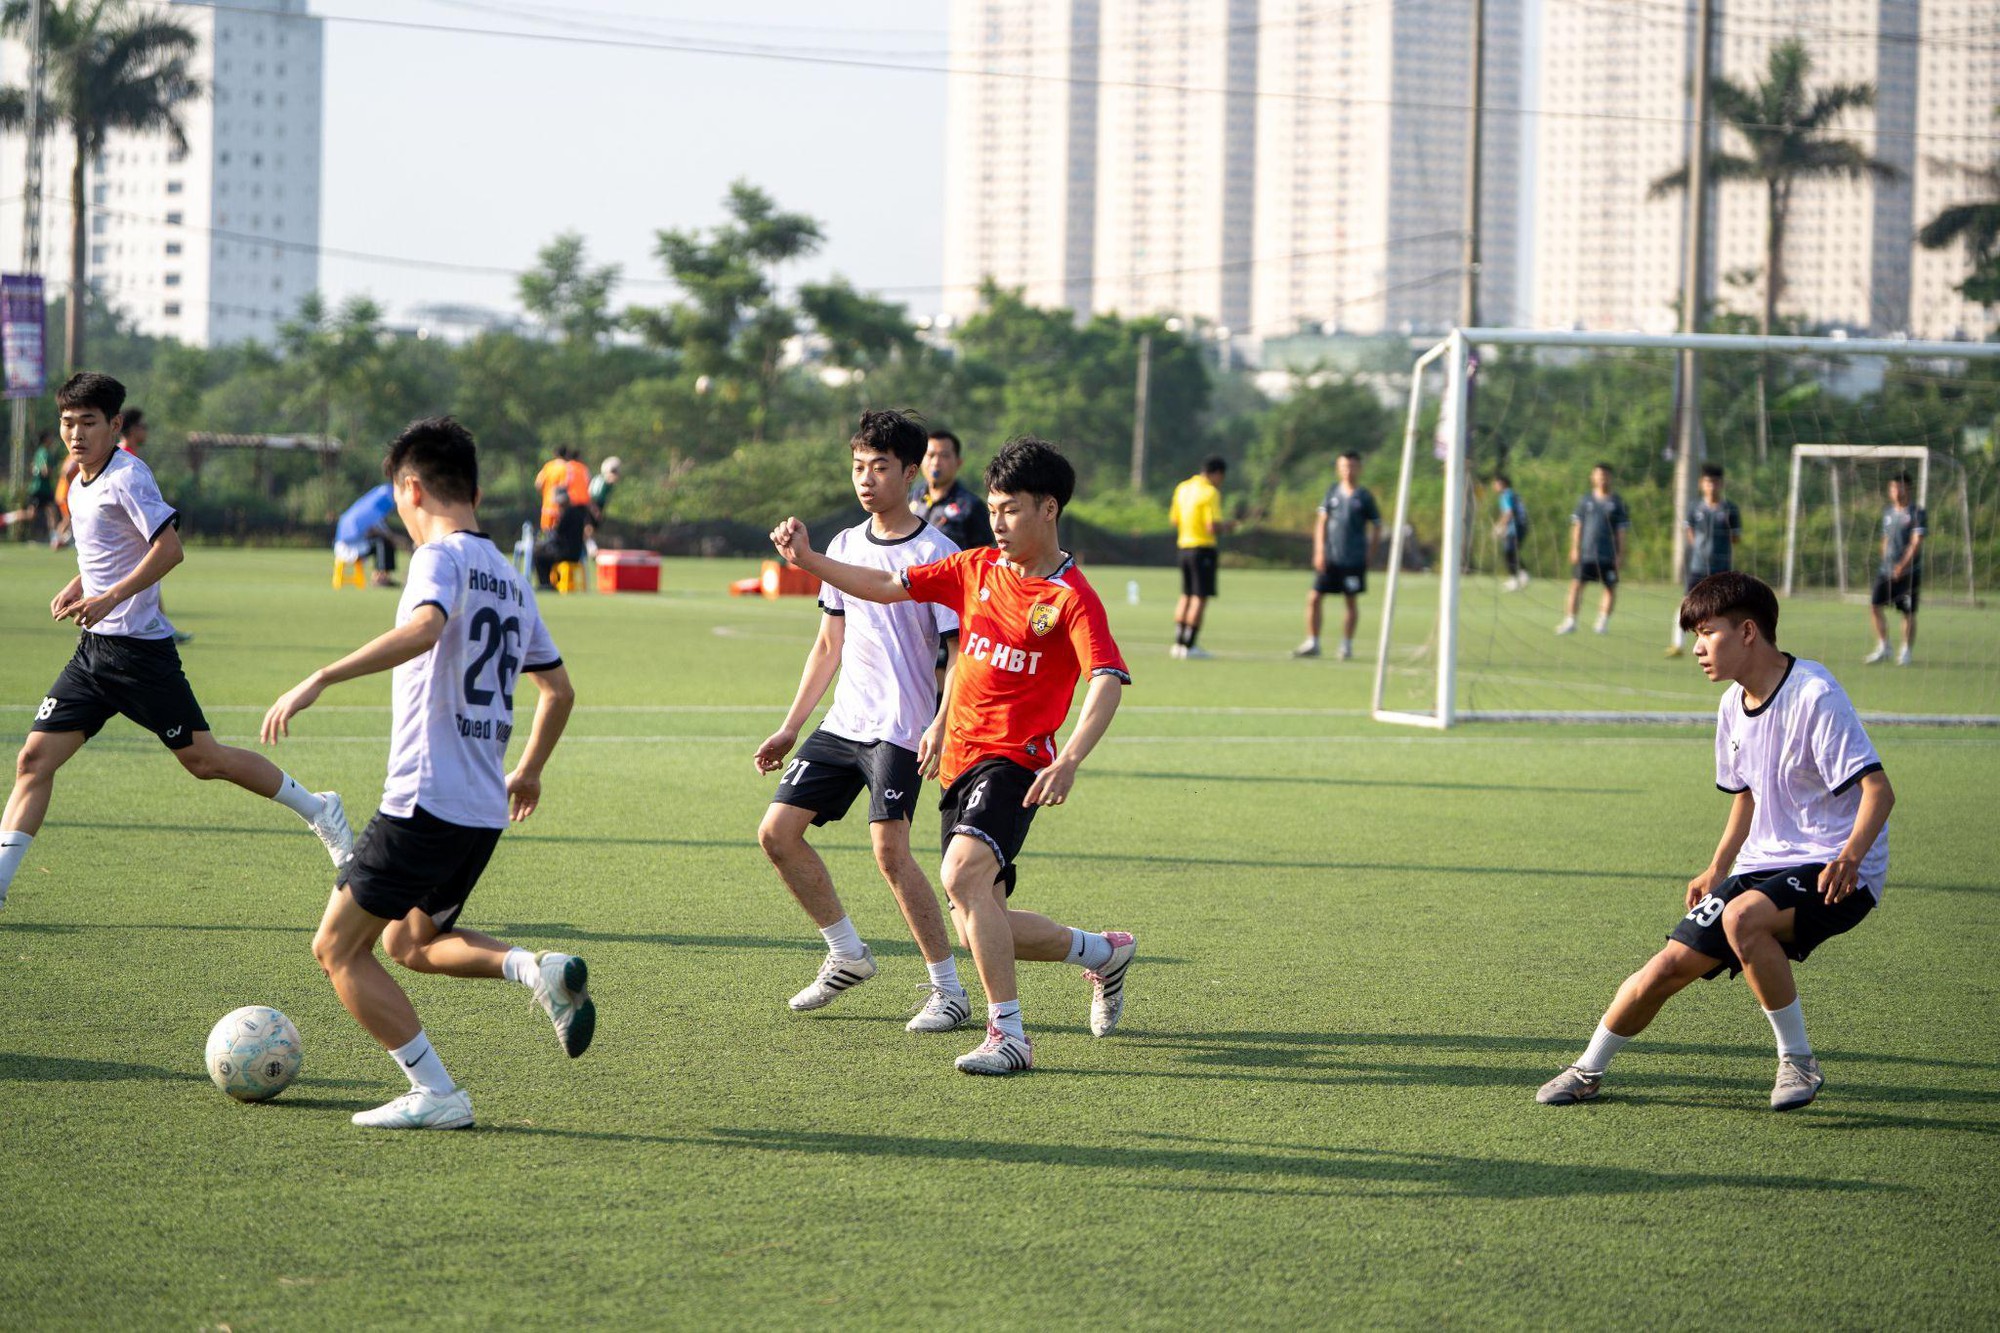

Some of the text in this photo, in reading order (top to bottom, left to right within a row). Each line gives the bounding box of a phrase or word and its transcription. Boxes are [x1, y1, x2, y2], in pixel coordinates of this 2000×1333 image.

[464, 606, 522, 711] 26
[964, 632, 1043, 675] FC HBT
[779, 758, 811, 786] 21
[965, 779, 988, 811] 6
[1683, 893, 1725, 928] 29
